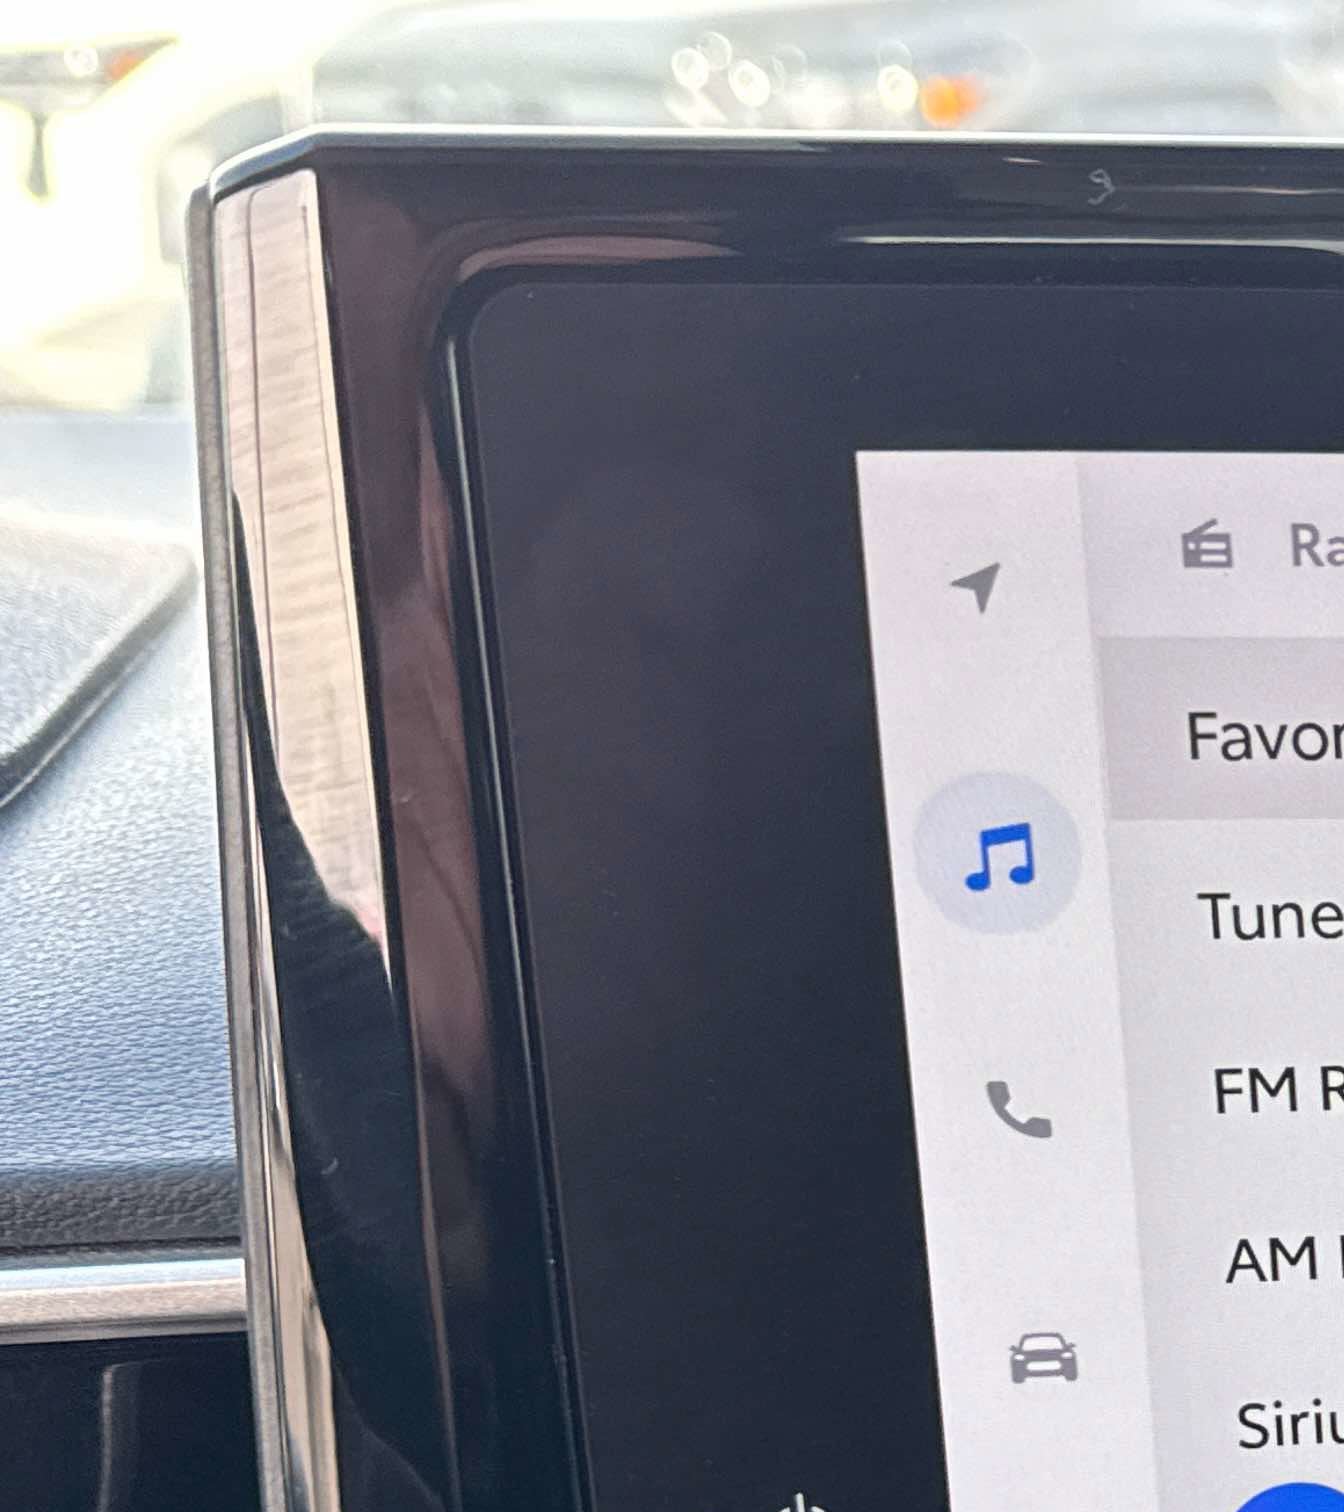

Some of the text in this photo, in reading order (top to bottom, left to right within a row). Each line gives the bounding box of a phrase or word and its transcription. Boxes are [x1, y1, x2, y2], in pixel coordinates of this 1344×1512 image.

[1196, 892, 1344, 941] Tune
[1214, 1066, 1298, 1114] FM
[1225, 1235, 1318, 1284] AM
